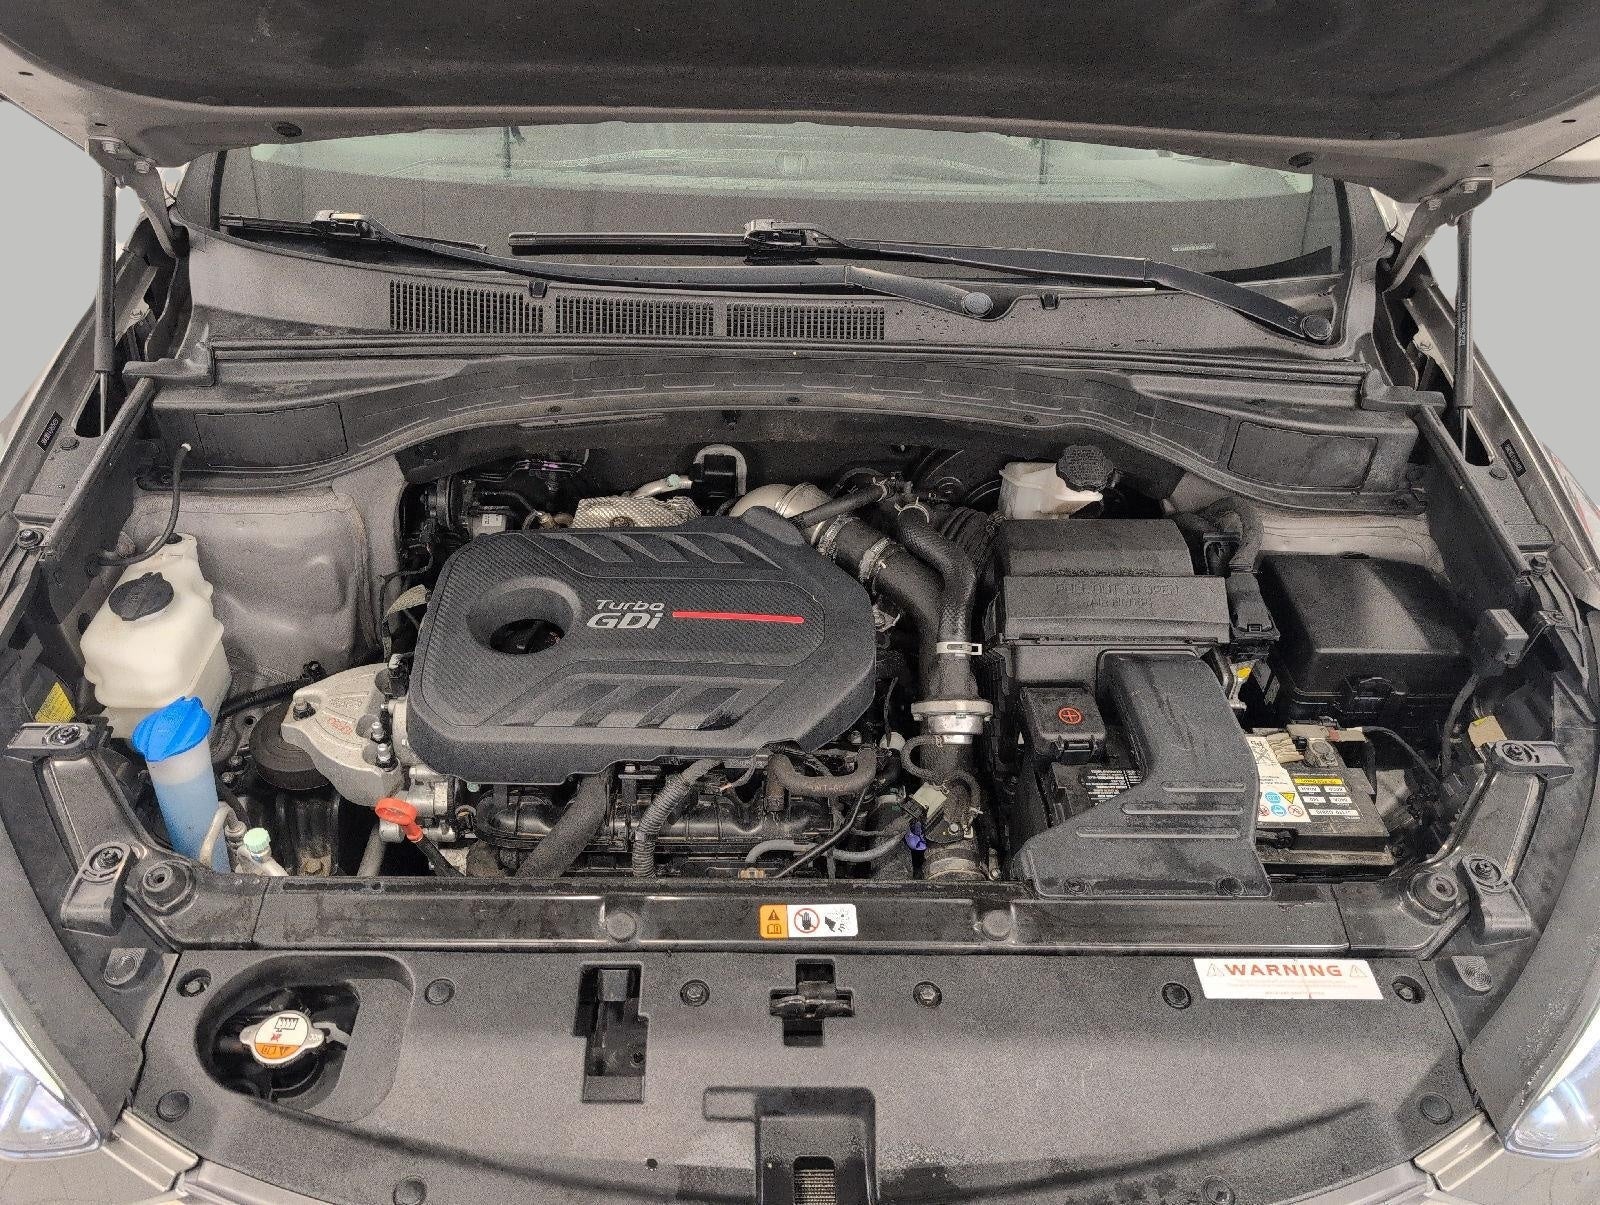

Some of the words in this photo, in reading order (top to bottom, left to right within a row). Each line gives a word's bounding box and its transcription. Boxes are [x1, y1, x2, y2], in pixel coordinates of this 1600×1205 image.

[596, 599, 665, 611] Turbo
[586, 612, 664, 630] GDi
[1224, 963, 1343, 977] WARNING
